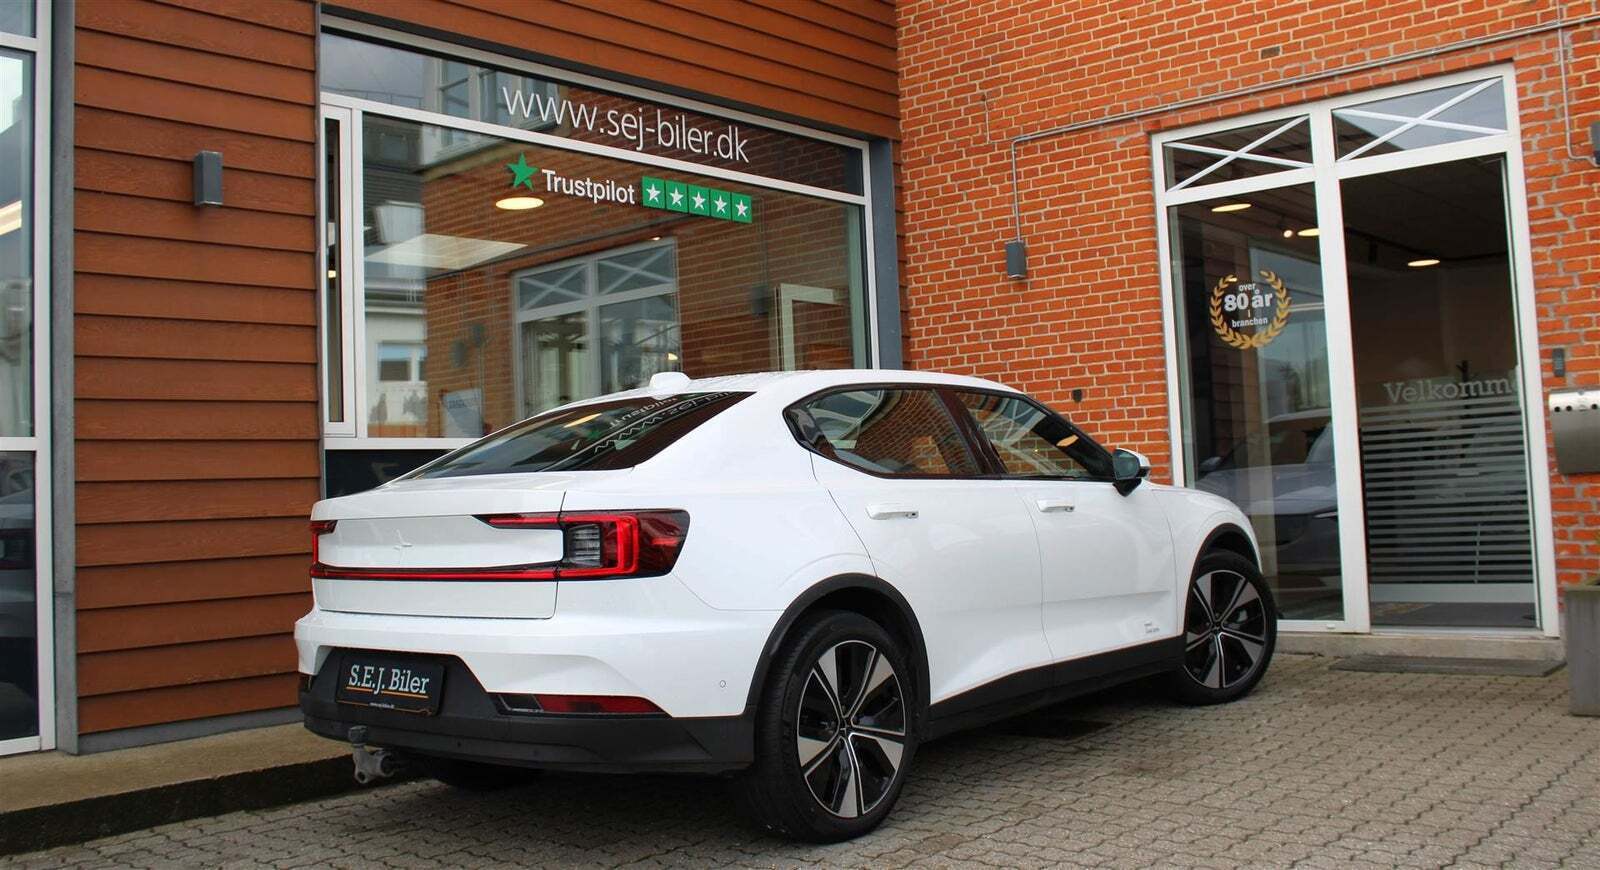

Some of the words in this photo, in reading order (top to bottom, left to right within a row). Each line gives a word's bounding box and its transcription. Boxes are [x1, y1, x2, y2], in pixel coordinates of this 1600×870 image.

[502, 86, 749, 163] www.sej-biler.dk
[541, 168, 635, 205] Trustpilot
[1224, 292, 1249, 312] 80
[1251, 289, 1273, 308] år
[1238, 283, 1256, 291] over
[1231, 316, 1268, 328] branchen
[348, 664, 385, 695] S.E.J.
[388, 668, 430, 694] Biler
